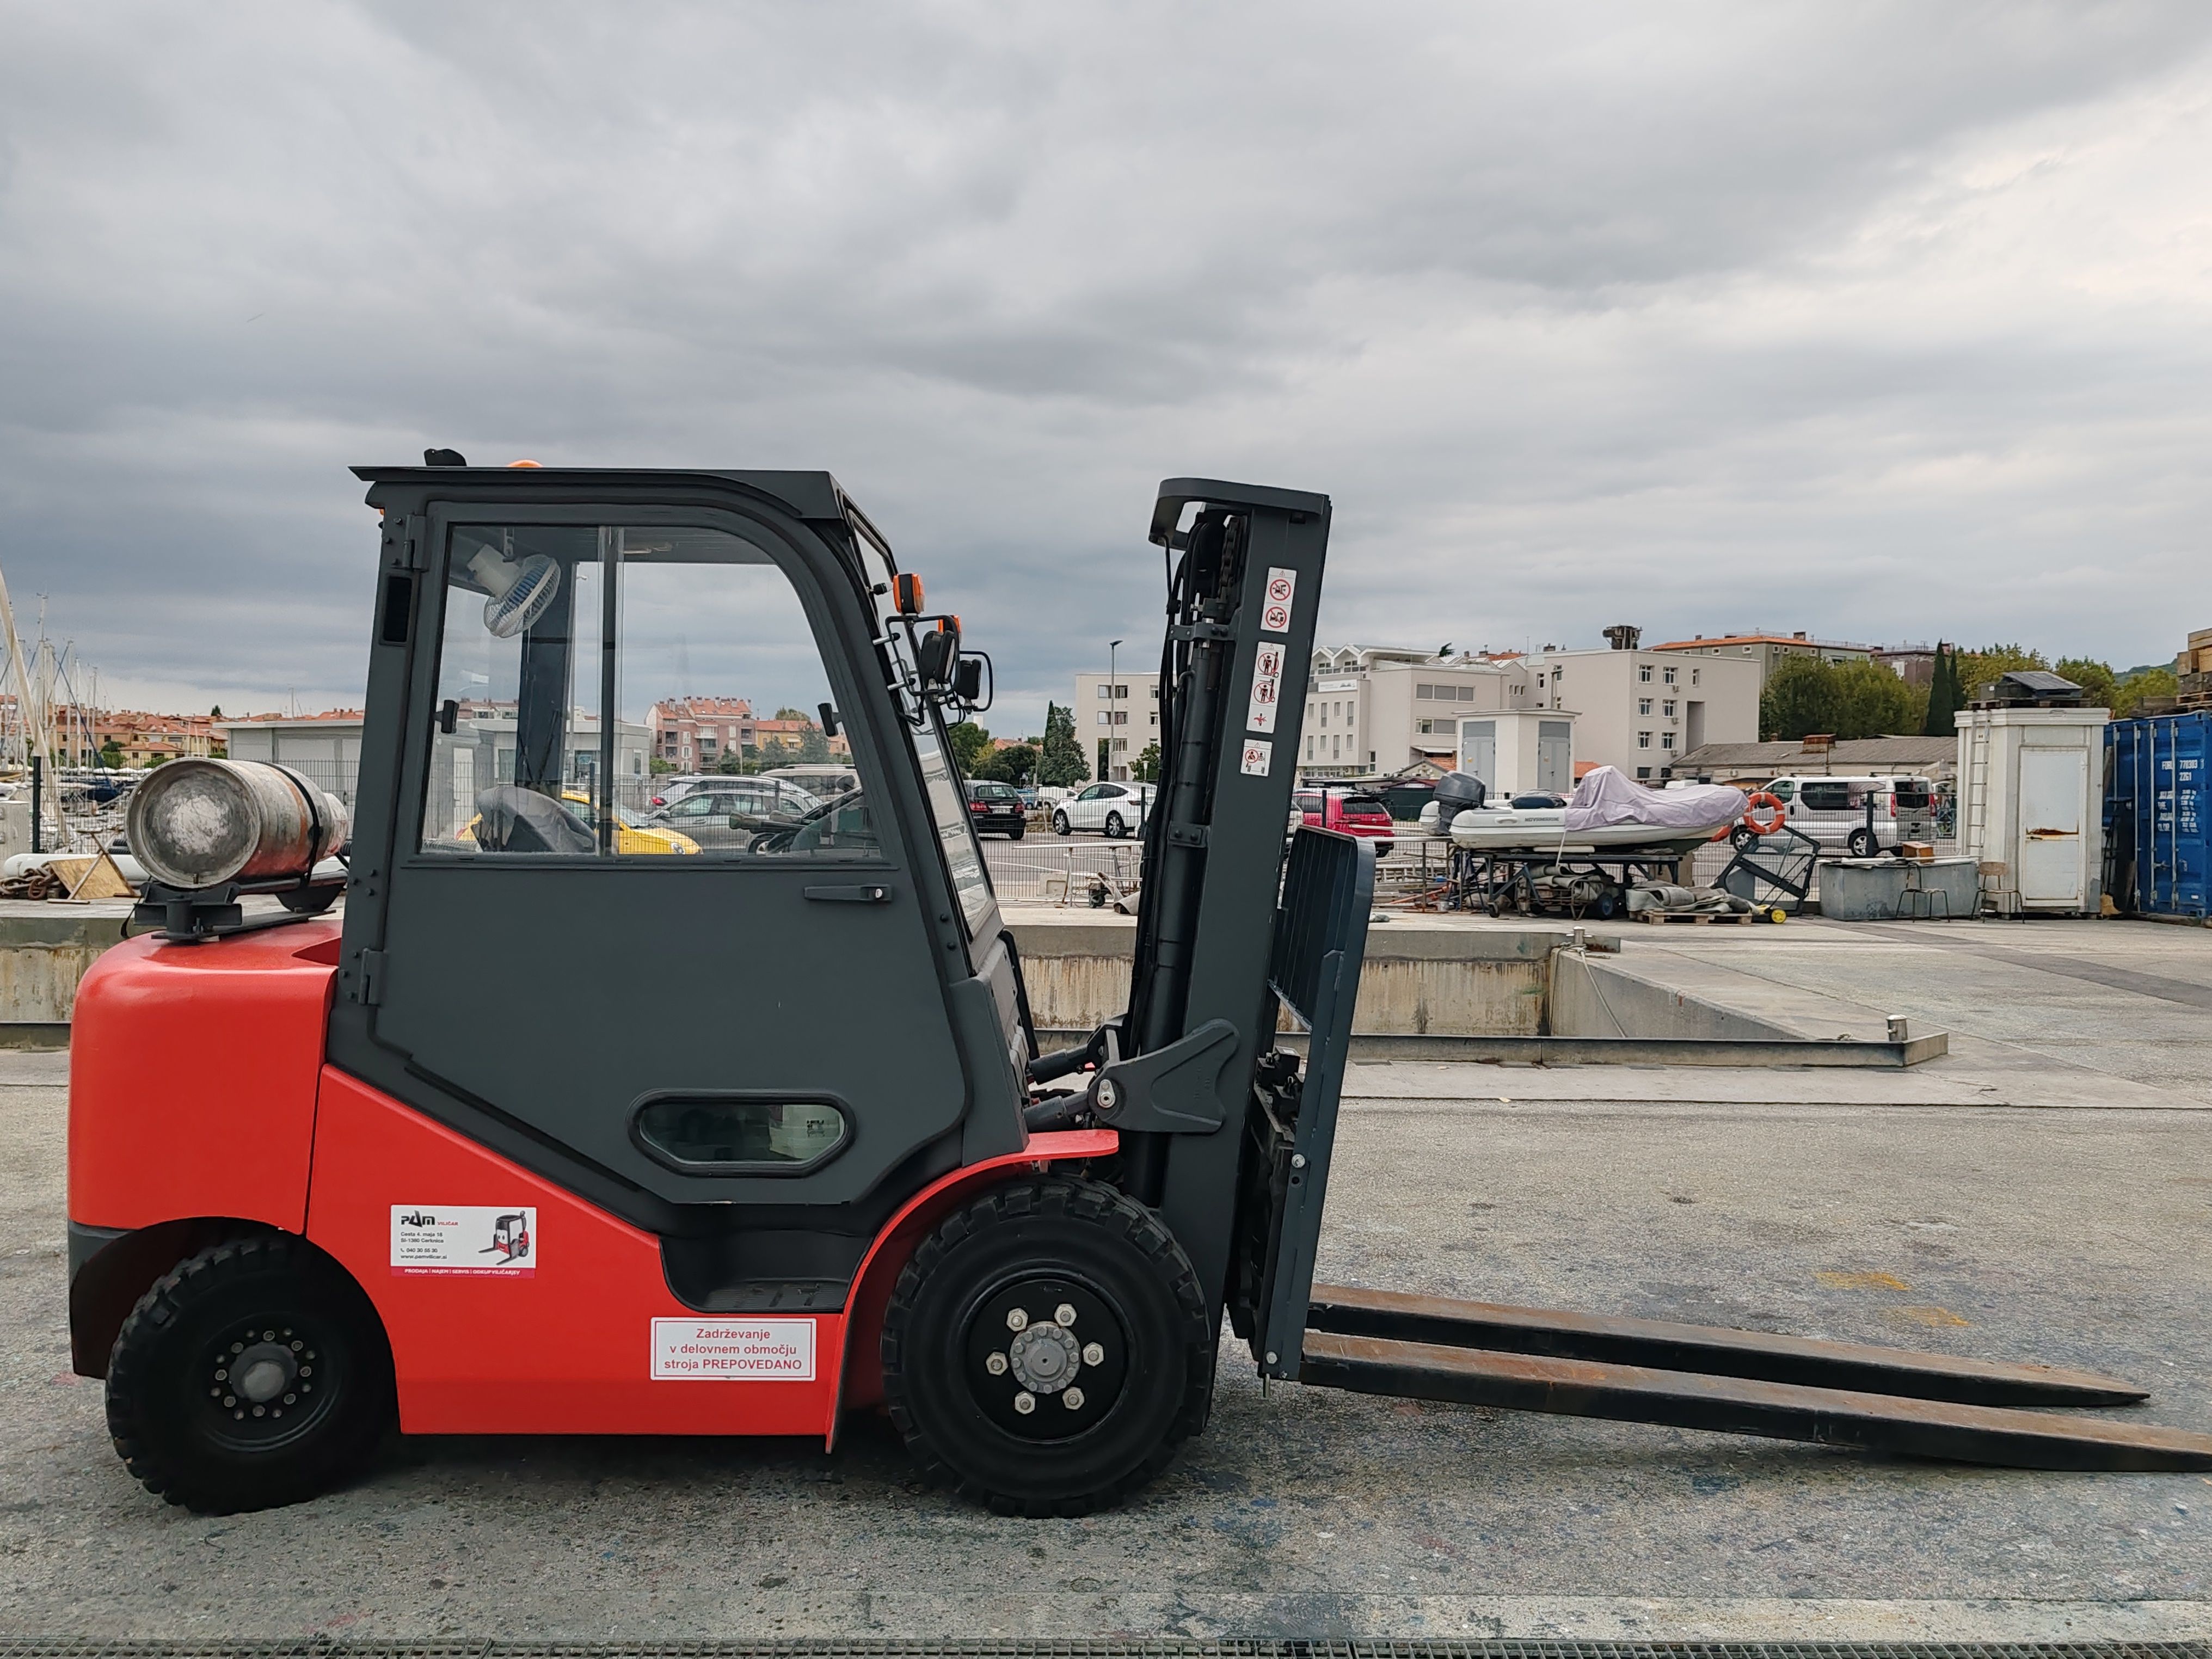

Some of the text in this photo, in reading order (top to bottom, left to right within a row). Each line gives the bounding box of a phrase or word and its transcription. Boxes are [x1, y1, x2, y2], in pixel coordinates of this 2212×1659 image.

[401, 1210, 435, 1227] PAM
[696, 1328, 771, 1341] Zadrževanje
[669, 1344, 797, 1357] v delovnem območju
[664, 1359, 802, 1371] stroja PREPOVEDANO
